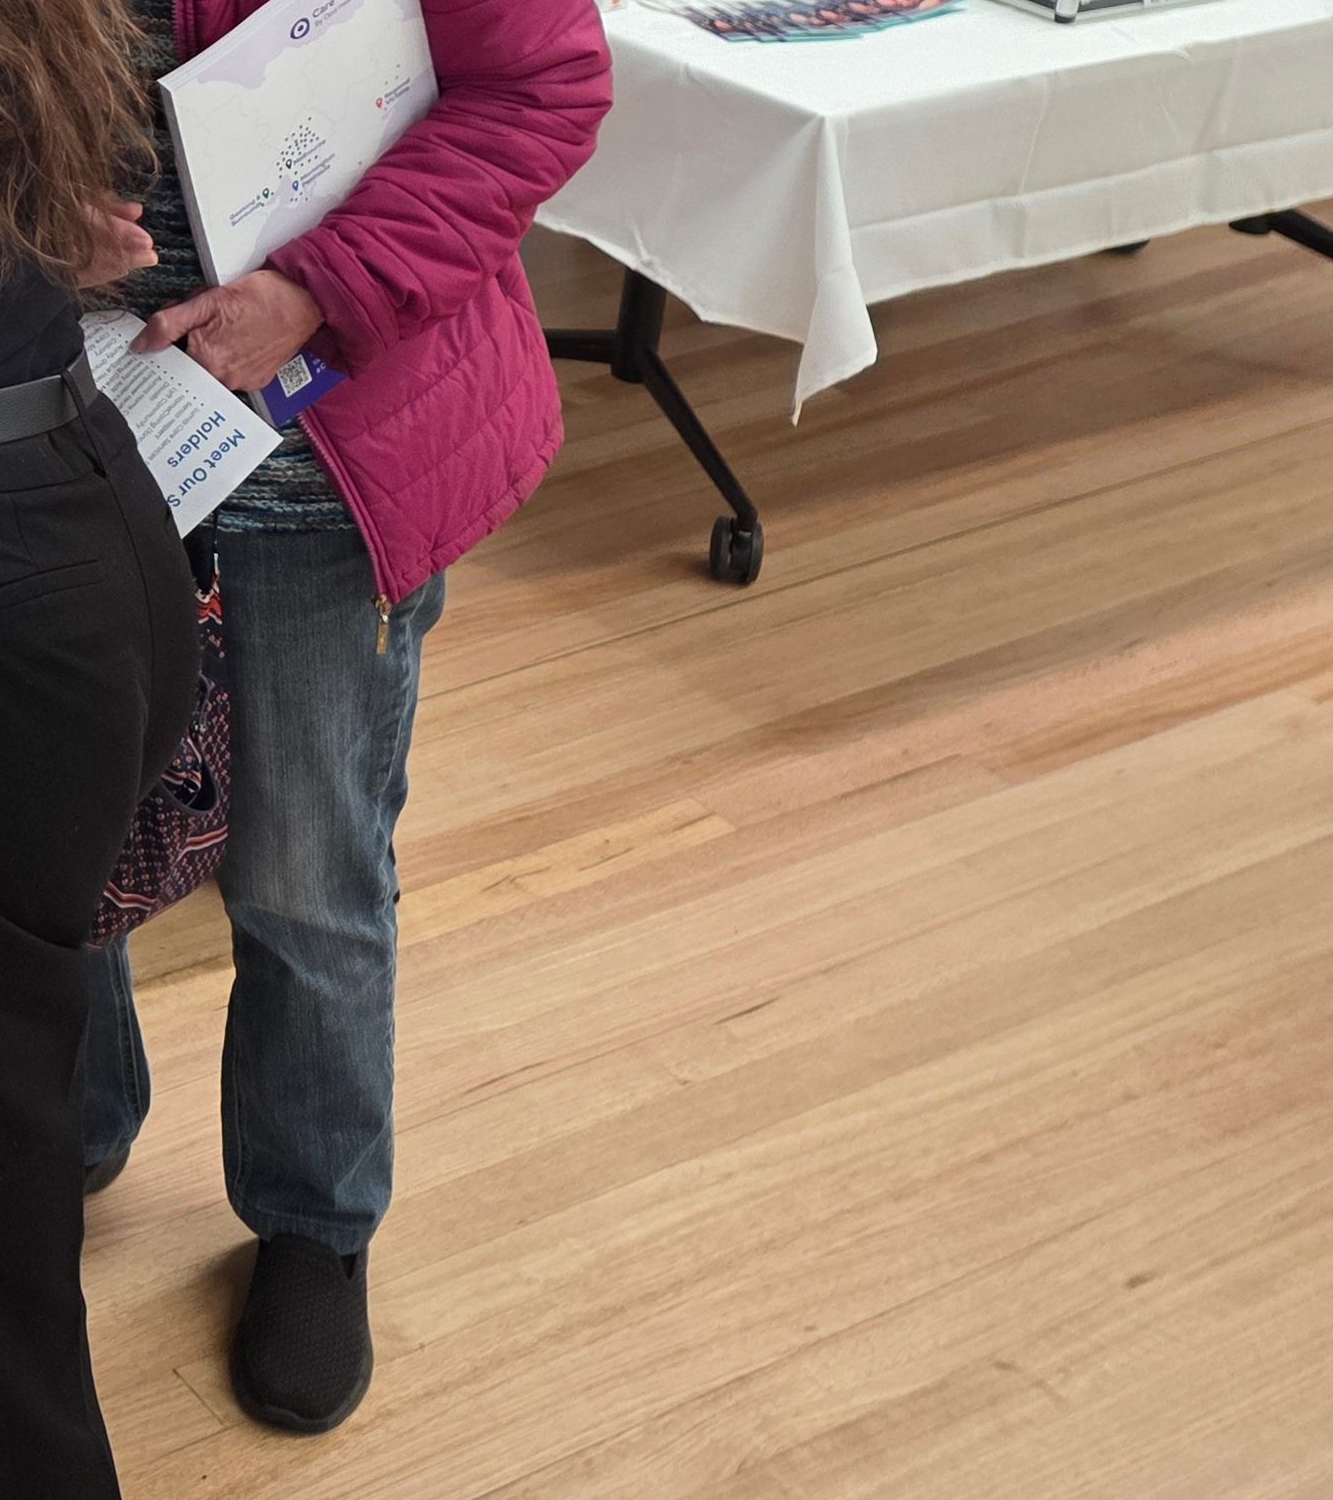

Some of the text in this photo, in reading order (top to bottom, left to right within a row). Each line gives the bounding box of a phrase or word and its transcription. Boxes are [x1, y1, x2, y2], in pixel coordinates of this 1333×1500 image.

[167, 410, 226, 468] Holders
[203, 429, 246, 469] Meet
[177, 469, 208, 497] Our
